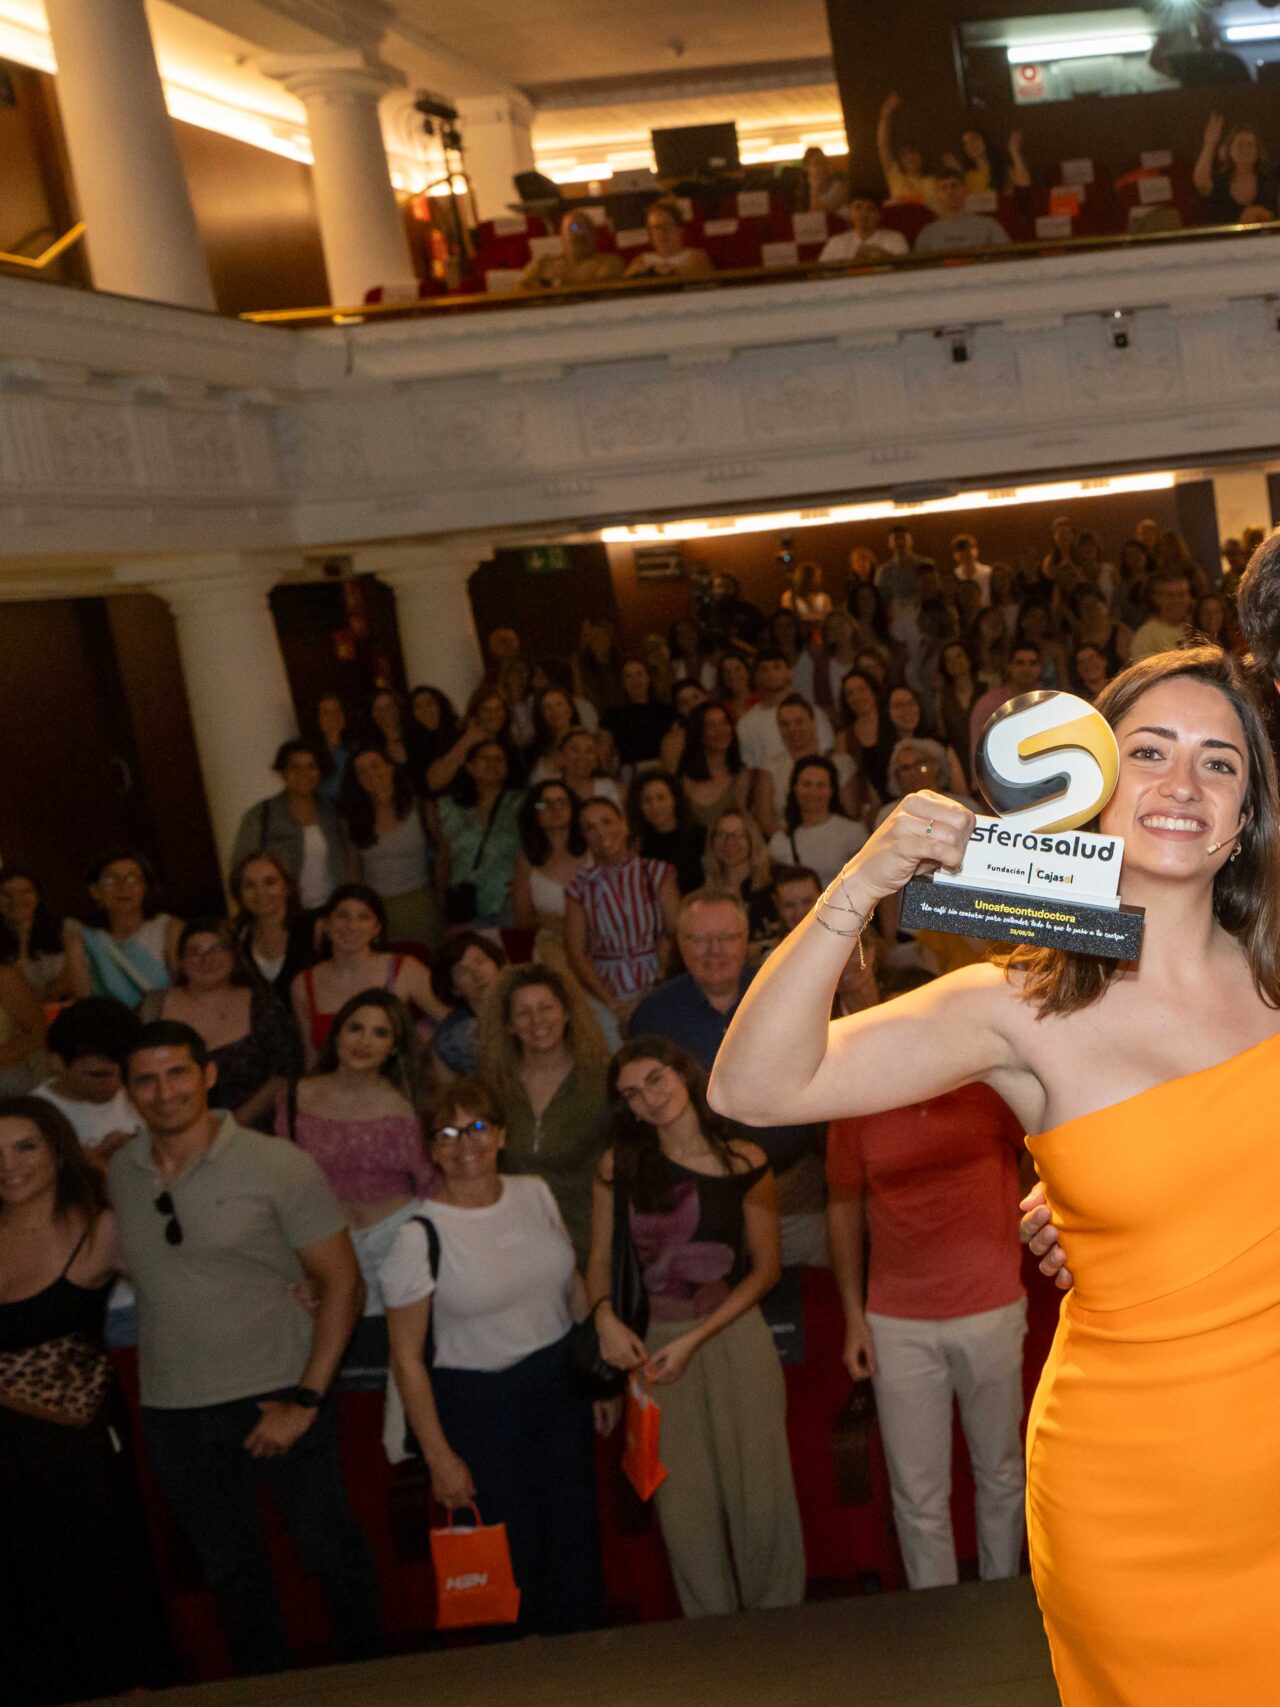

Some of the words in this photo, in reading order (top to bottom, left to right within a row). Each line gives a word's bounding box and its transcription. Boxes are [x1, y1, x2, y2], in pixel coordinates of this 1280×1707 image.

[986, 863, 1026, 876] Fundación
[1035, 868, 1074, 884] Cajasol
[974, 899, 1076, 924] Uncafecontudoctora
